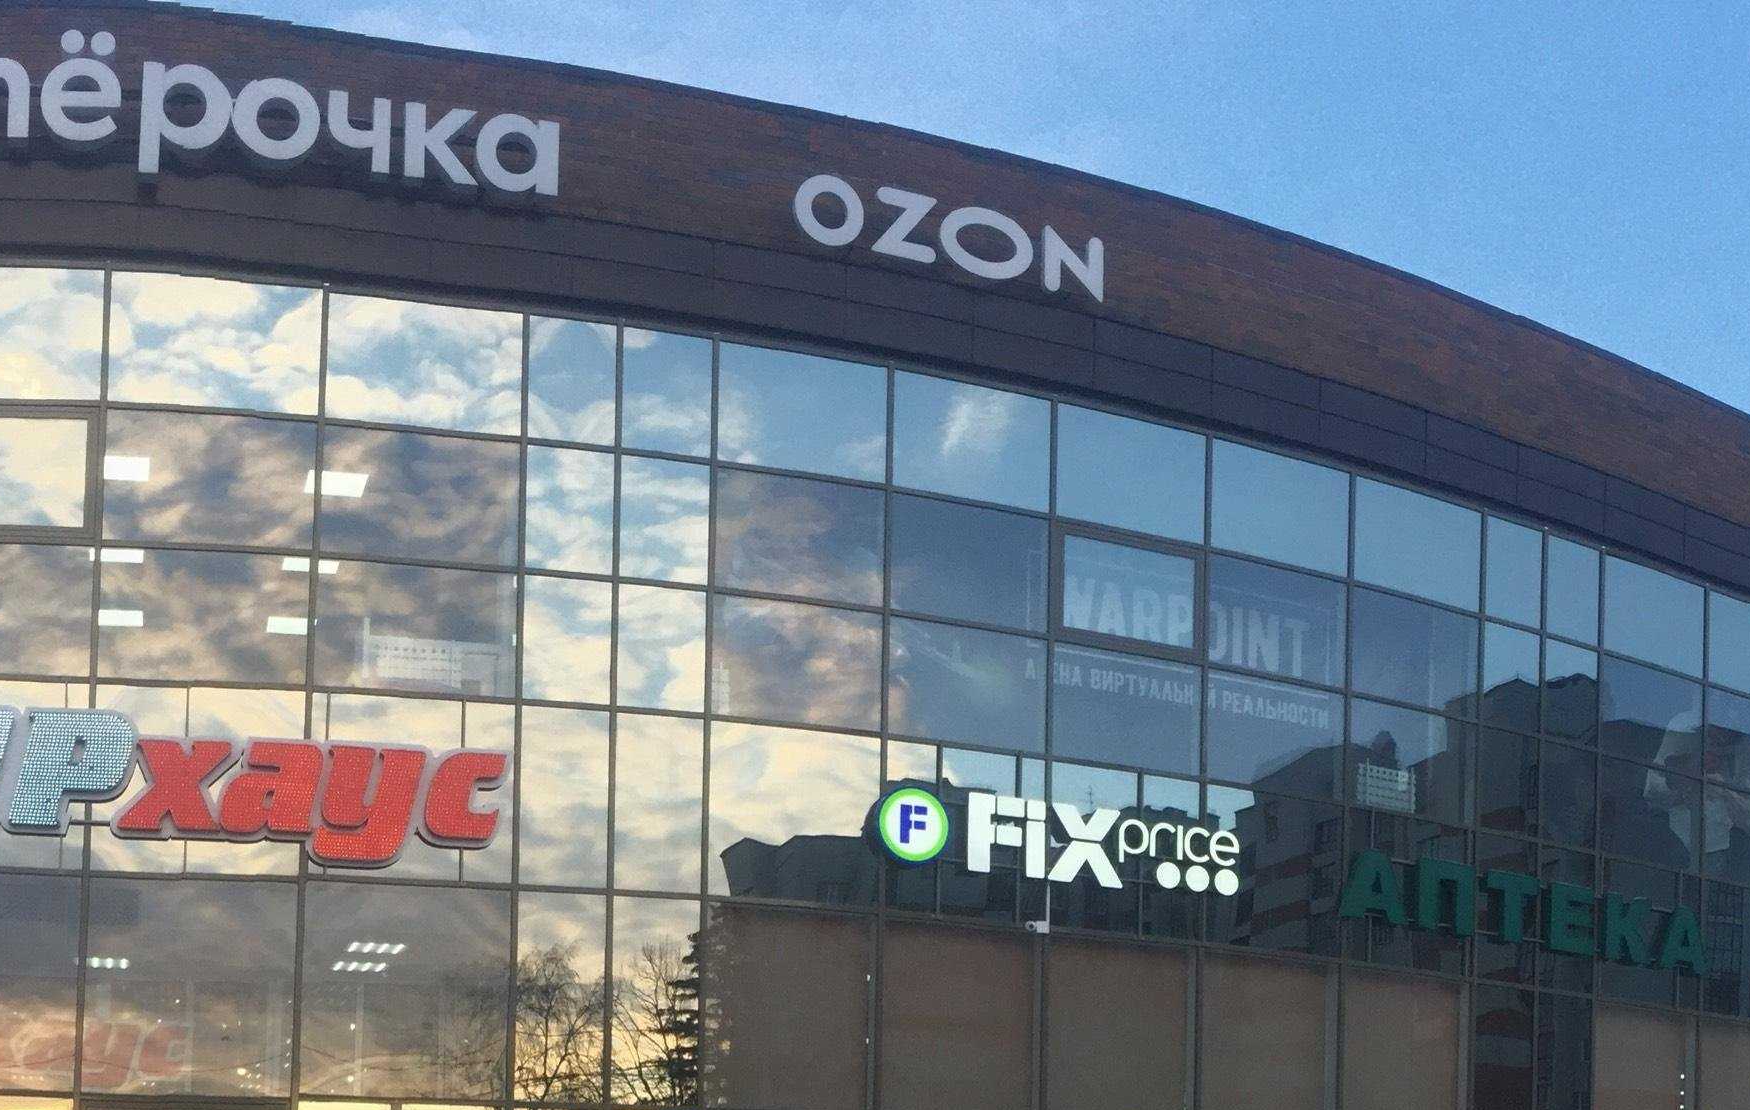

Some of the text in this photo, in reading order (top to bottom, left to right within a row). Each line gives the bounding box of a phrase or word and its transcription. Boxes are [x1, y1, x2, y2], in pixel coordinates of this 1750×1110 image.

[794, 172, 1106, 303] OZON
[1024, 658, 1330, 729] АНА ВИРТУАЛЬНЙ РЕАЛЬНОСТИ
[900, 803, 928, 844] F
[1118, 818, 1241, 867] price
[1339, 847, 1708, 974] АПТЕКА
